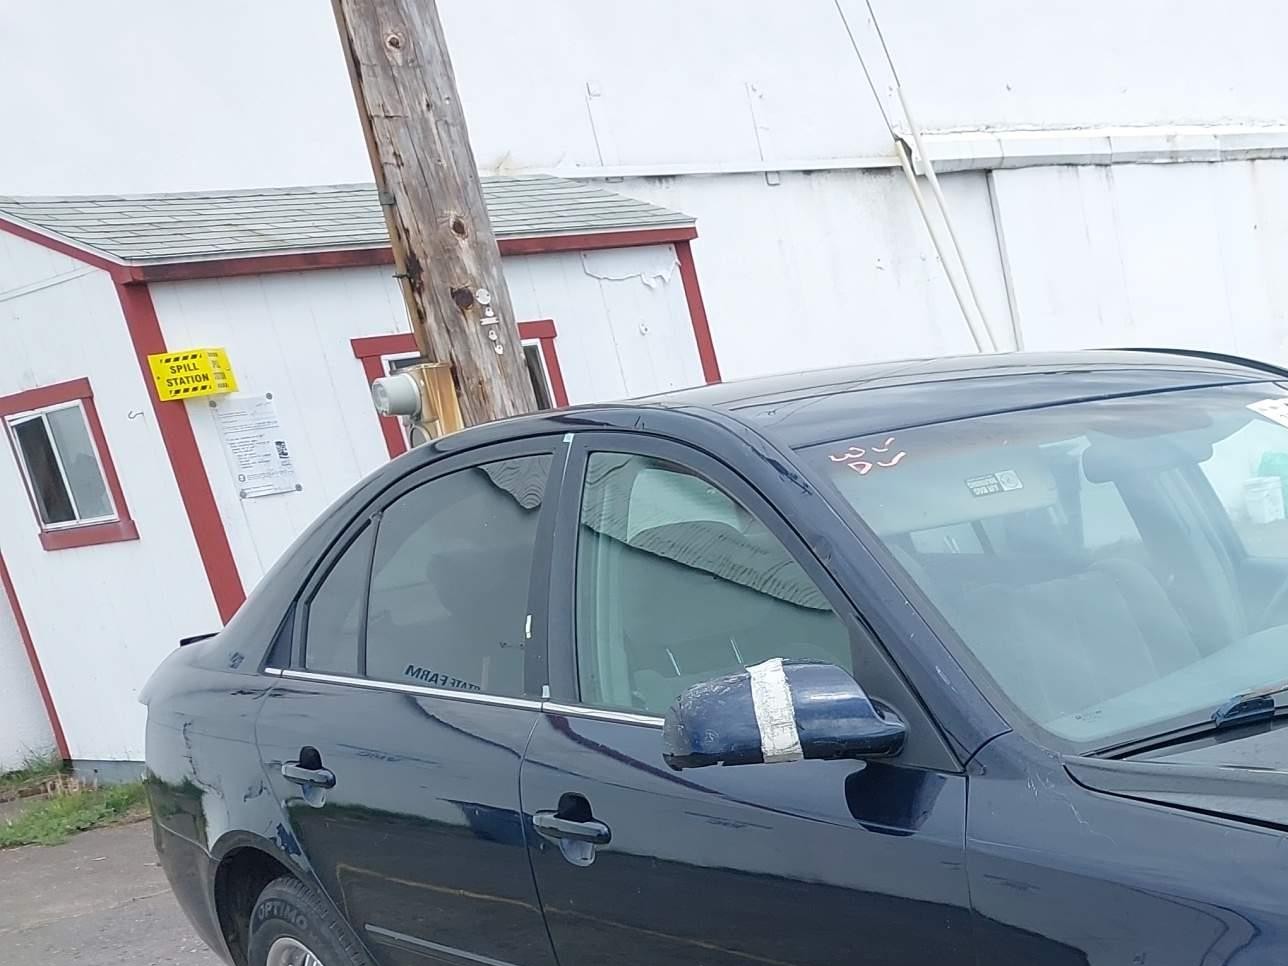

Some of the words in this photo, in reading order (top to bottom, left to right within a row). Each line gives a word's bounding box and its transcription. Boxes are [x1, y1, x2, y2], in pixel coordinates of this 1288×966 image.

[169, 362, 200, 375] SPILL
[166, 372, 210, 387] STATION
[257, 901, 308, 930] OPTIMO
